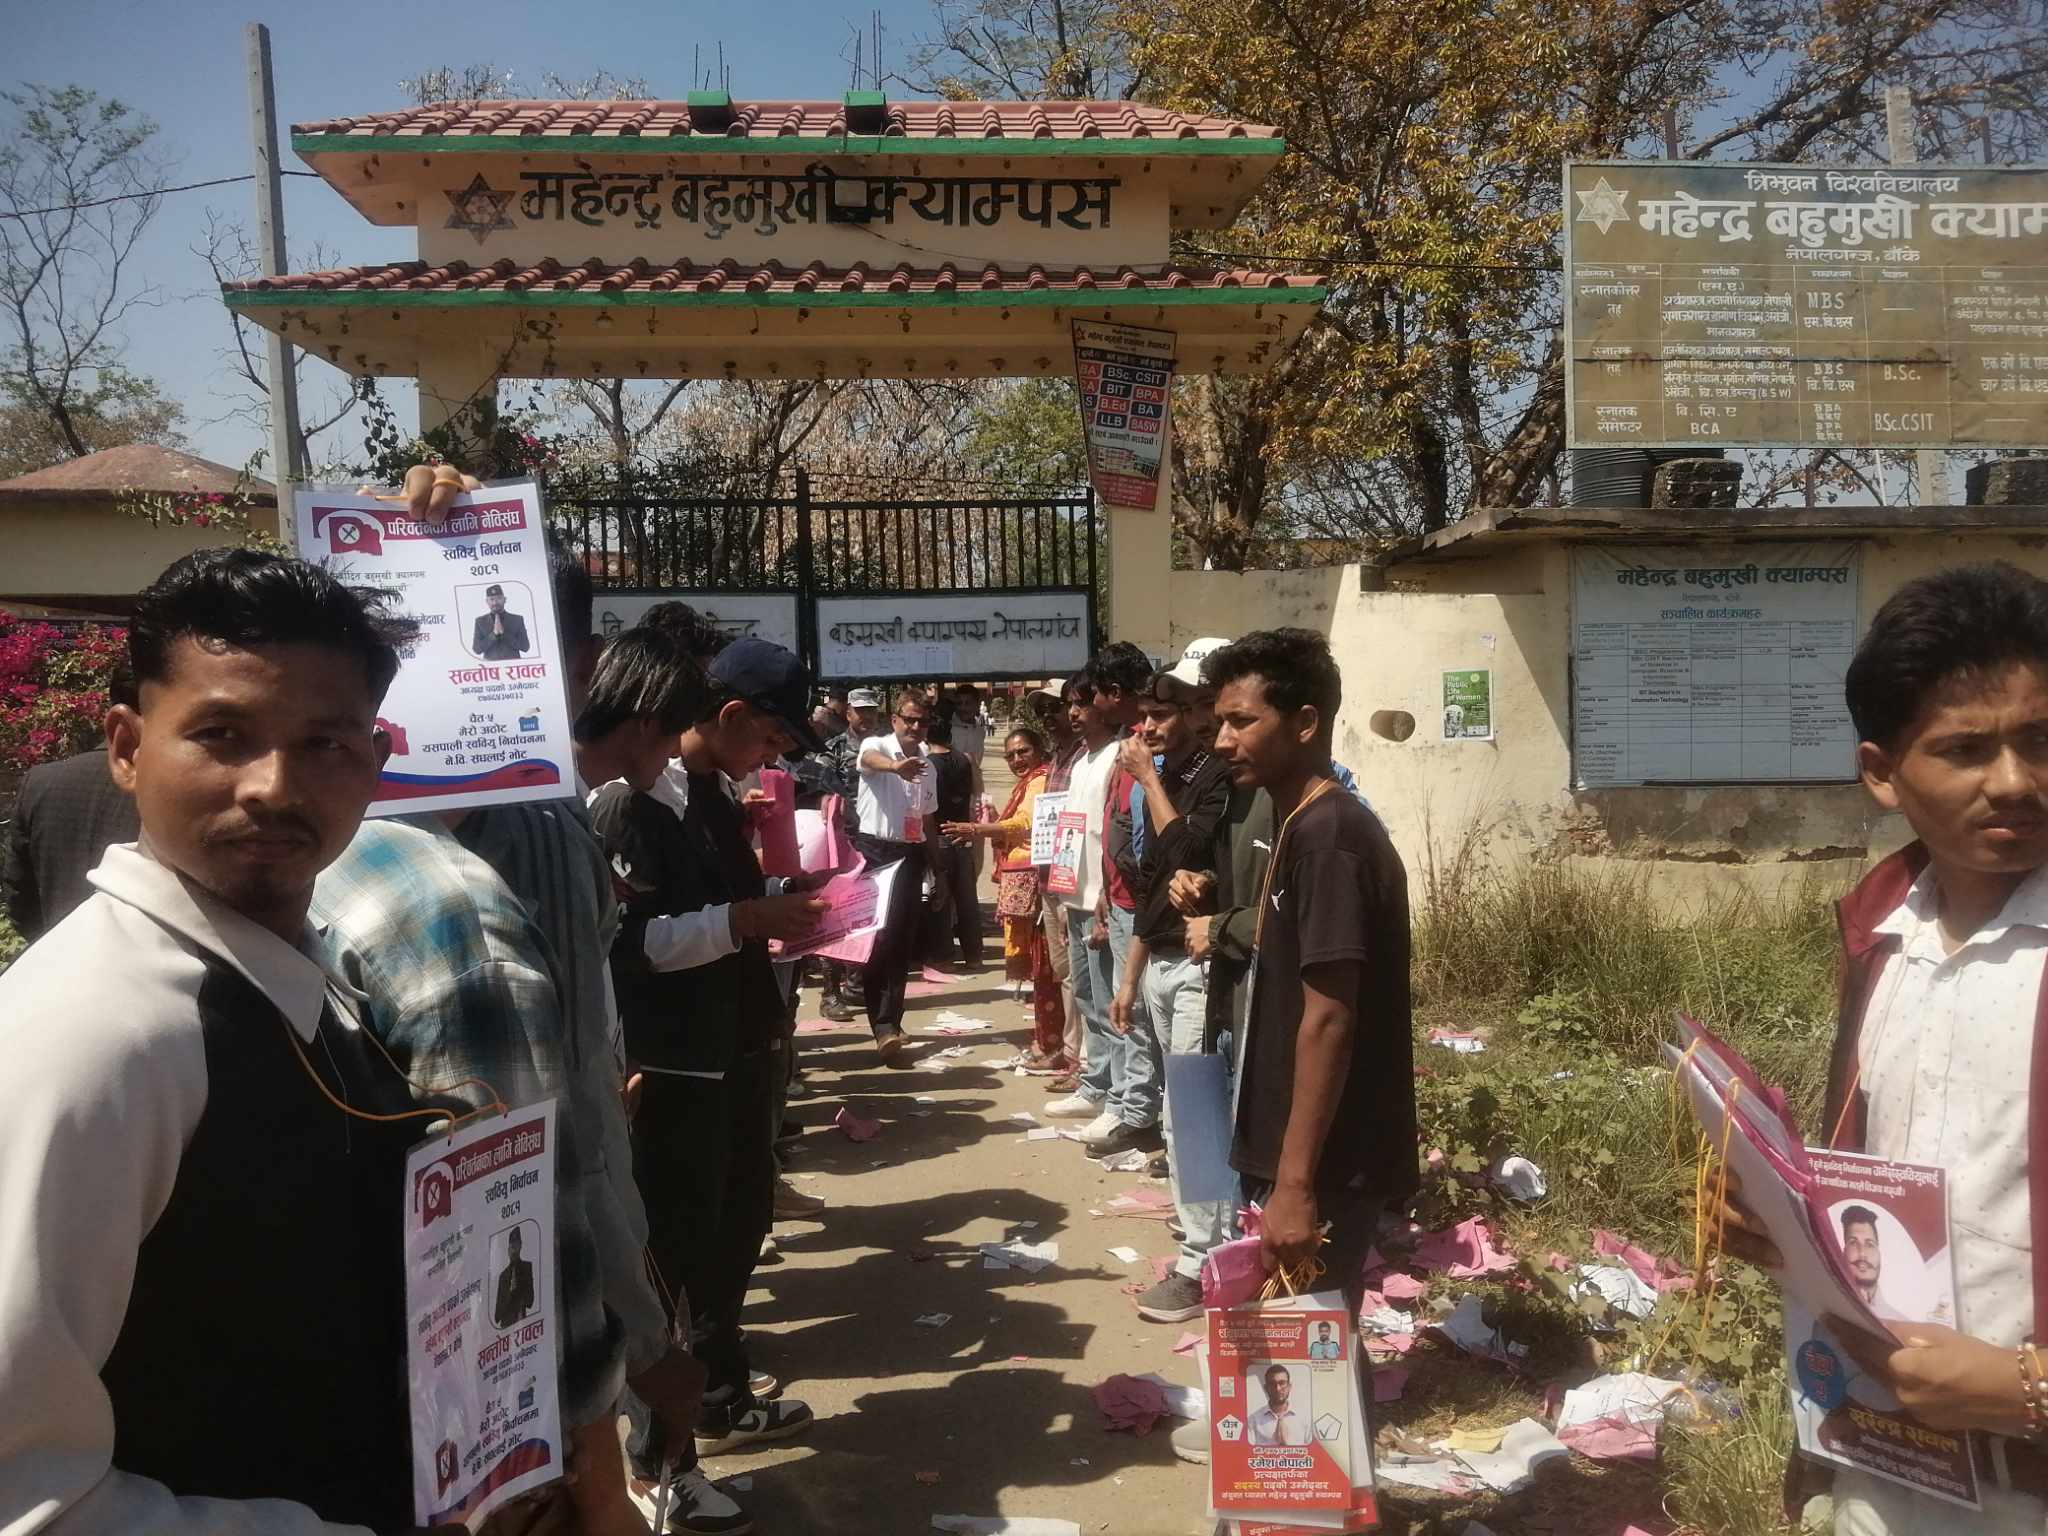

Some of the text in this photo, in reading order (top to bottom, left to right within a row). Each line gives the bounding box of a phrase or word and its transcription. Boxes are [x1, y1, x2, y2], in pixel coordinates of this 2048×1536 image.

[1744, 169, 1961, 197] त्रिभुवन विश्वविद्यालय
[519, 158, 664, 230] महेन्द्र
[671, 161, 837, 240] बहुमुखी
[1637, 190, 1757, 242] महेन्द्र
[1764, 193, 1921, 248] बहुमुखी
[1806, 292, 1845, 309] MBS
[1107, 367, 1162, 385] BSc. CSIT
[1813, 363, 1845, 376] BBS
[1883, 364, 1922, 381] B.Sc.
[1106, 383, 1126, 396] BIT
[1136, 388, 1160, 402] BPA
[1100, 400, 1127, 412] B.Ed
[1137, 405, 1155, 417] BA
[1100, 415, 1123, 428] LLB
[1690, 422, 1720, 434] BCA
[450, 513, 479, 534] लागि
[481, 509, 521, 530] नेविसंघ
[479, 540, 522, 558] निर्वाचन
[469, 564, 499, 577] २०८१
[1615, 563, 1850, 588] महेन्द्र बहुमुखी क्याम्पस
[828, 611, 1081, 647] बहुमुखी क्याम्पस नेपालगंज
[448, 663, 547, 686] सन्तोष रावल
[498, 733, 546, 747] निर्वाचनमा
[508, 747, 528, 760] भोट
[1248, 1455, 1314, 1469] रमेश नेपाली
[1262, 1479, 1288, 1490] पदको
